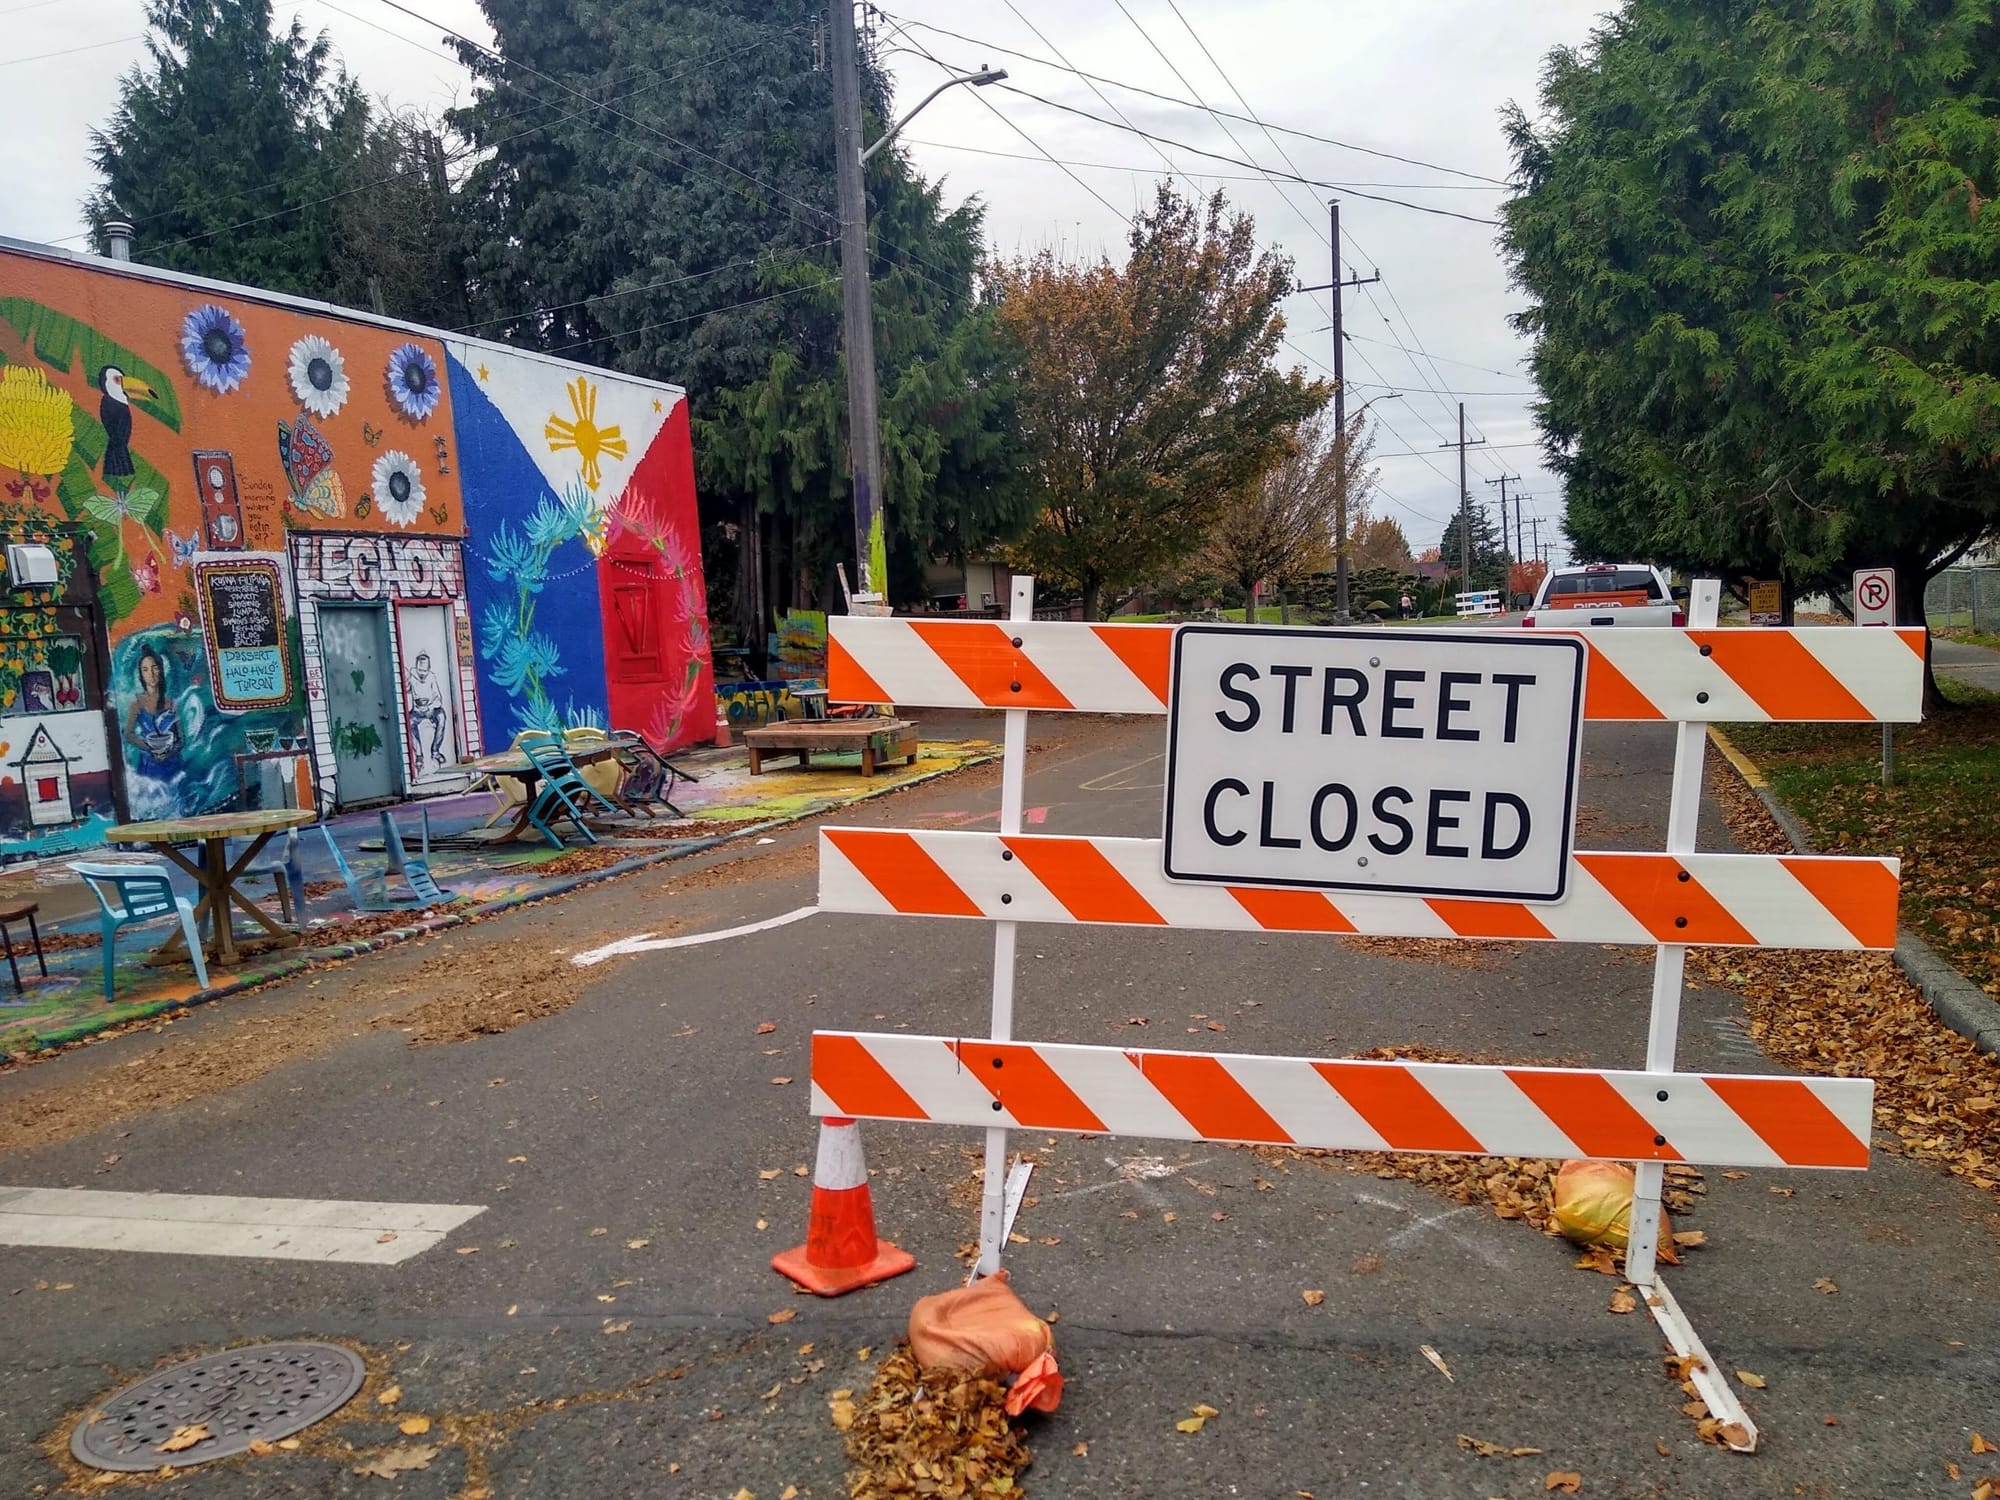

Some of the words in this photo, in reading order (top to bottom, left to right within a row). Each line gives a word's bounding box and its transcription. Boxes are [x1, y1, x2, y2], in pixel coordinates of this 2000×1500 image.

[296, 536, 460, 600] LECHON
[224, 650, 274, 662] DESSERT
[234, 676, 274, 692] TURON
[1215, 662, 1537, 743] STREET
[1203, 777, 1532, 861] CLOSED
